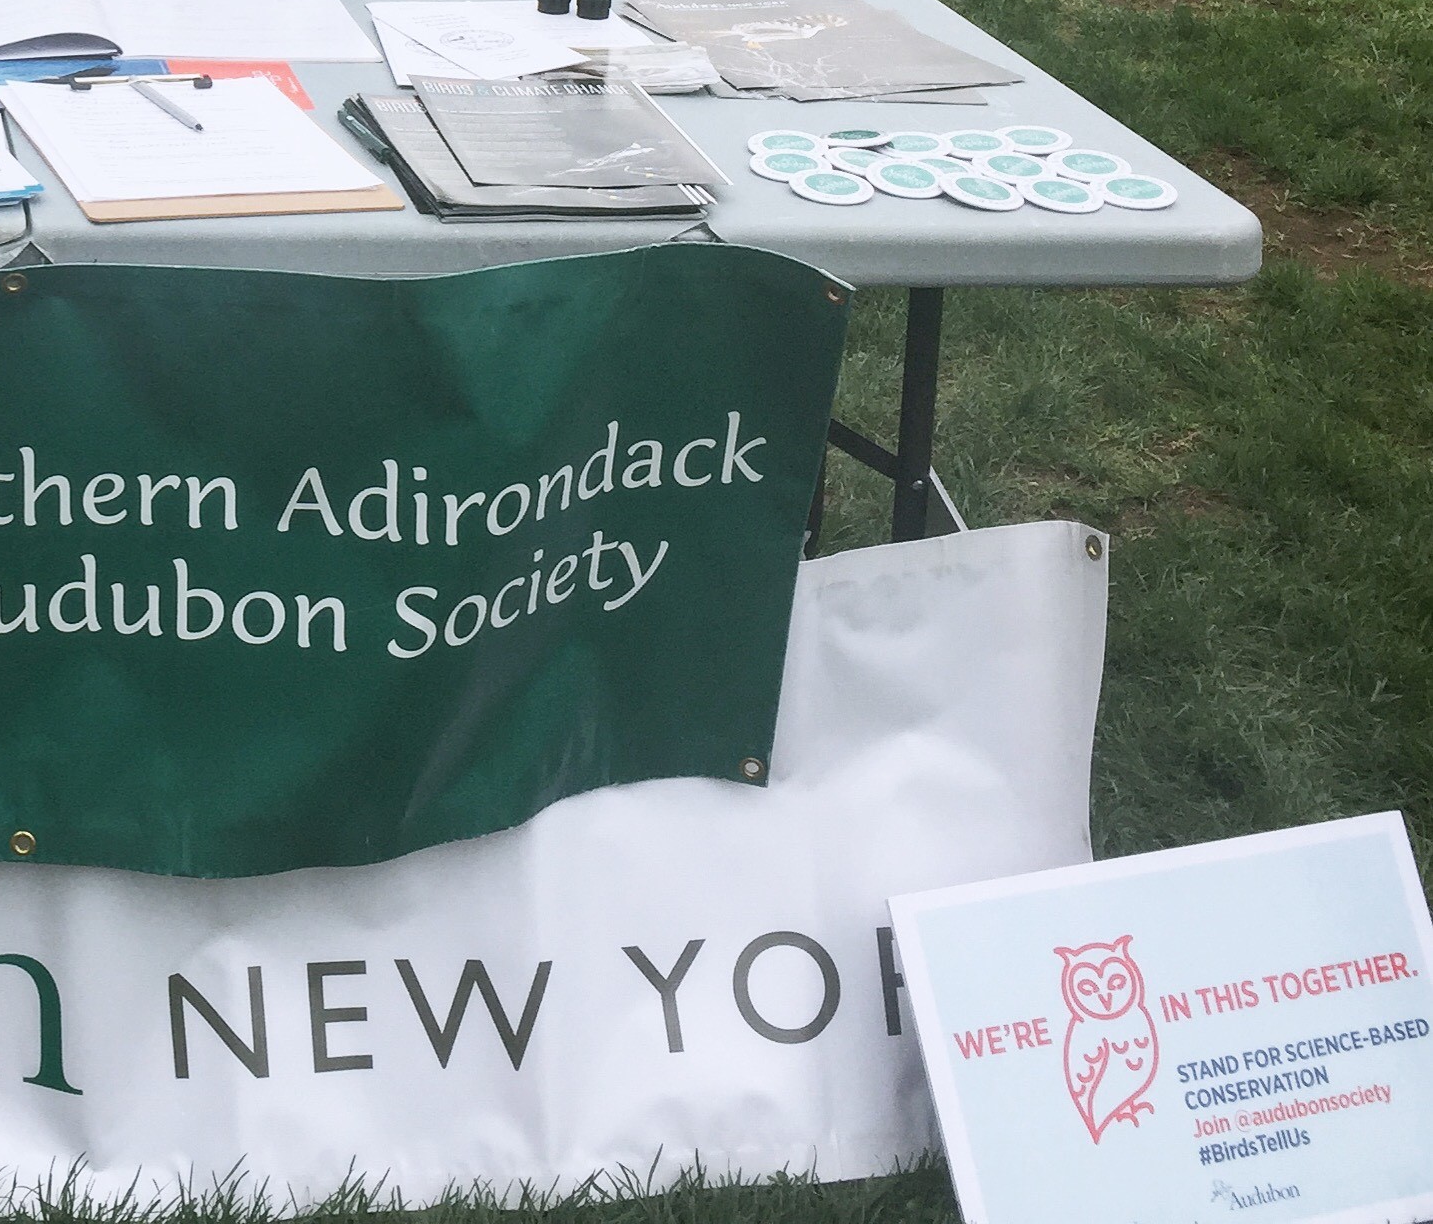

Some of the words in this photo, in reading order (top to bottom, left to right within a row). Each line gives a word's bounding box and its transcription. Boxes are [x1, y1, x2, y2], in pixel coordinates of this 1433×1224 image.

[421, 81, 474, 96] BIRDS
[493, 83, 563, 97] CLIMATE
[276, 410, 767, 548] Adirondack
[386, 529, 670, 659] Society
[165, 959, 553, 1082] NEW
[620, 926, 906, 1058] YO
[1160, 994, 1191, 1024] IN
[1195, 981, 1260, 1016] THIS
[1263, 951, 1419, 1002] TOGETHER.
[954, 1017, 1053, 1060] WE'RE
[1177, 1044, 1239, 1084] STAND
[1243, 1038, 1282, 1072] FOR
[1286, 1017, 1431, 1063] SCIENCE-BASED
[1184, 1066, 1330, 1111] CONSERVATION
[1193, 1116, 1232, 1140] Join
[1235, 1083, 1393, 1130] @audubonsociety
[1199, 1128, 1312, 1166] #BirdsTellUs
[1230, 1182, 1301, 1210] Audubon
